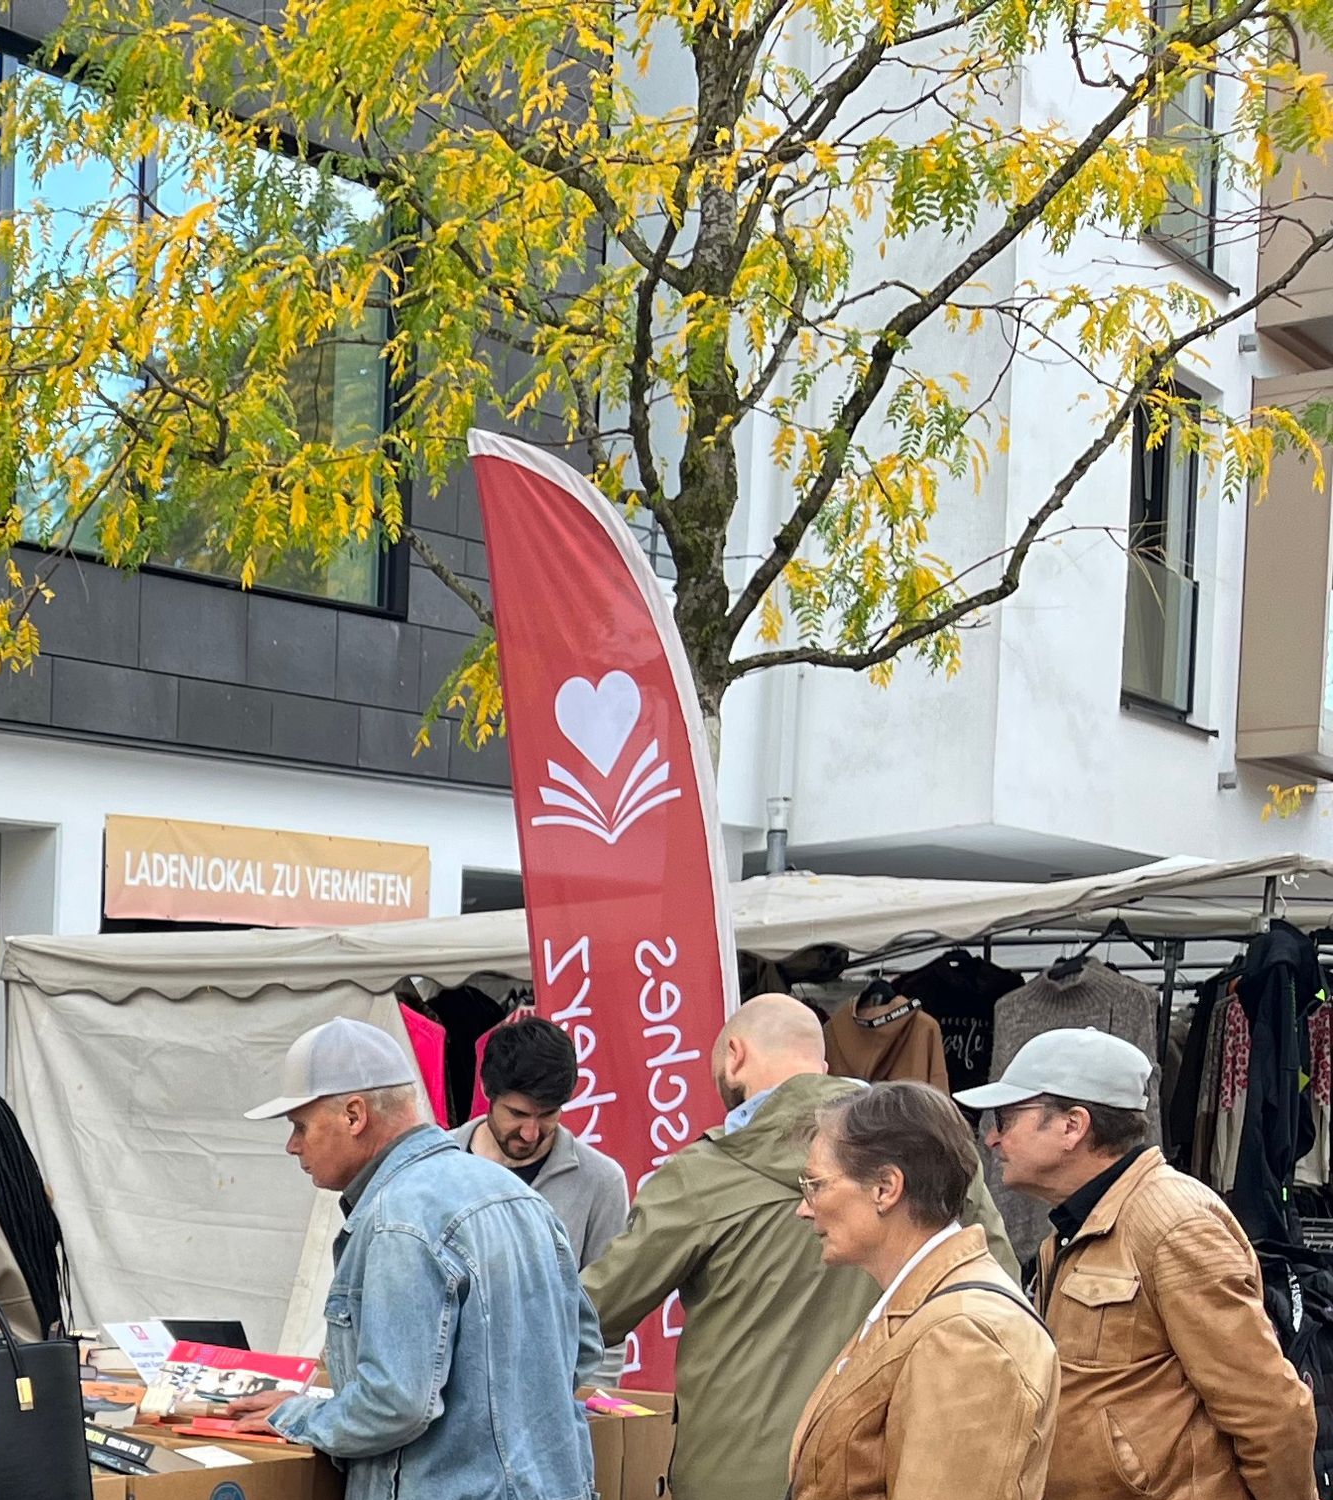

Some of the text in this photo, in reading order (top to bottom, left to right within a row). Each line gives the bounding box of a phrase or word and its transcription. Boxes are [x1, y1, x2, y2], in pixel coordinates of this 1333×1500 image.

[124, 850, 412, 908] LADENLOKAL ZU VERMIETEN
